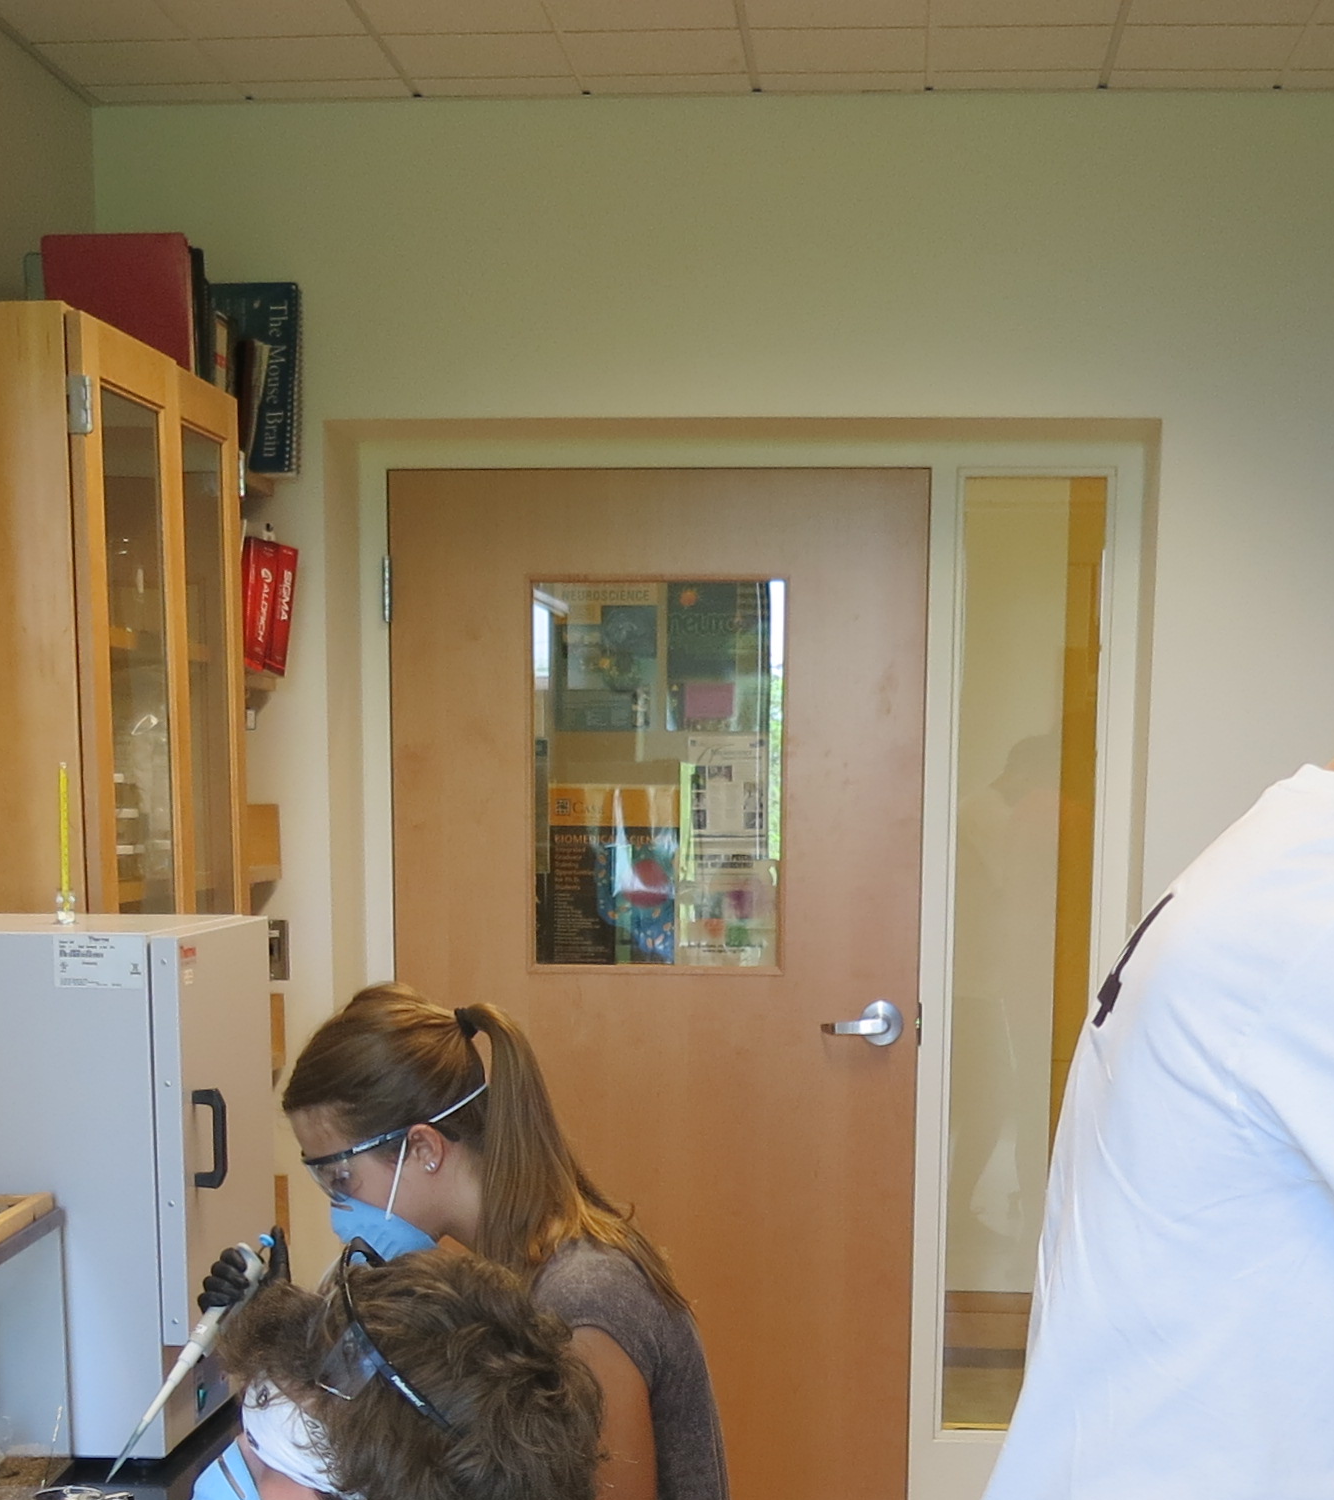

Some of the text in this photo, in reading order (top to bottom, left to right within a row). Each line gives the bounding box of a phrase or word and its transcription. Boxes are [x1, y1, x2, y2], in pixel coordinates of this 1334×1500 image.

[262, 299, 289, 458] The Mouse Brain
[257, 584, 271, 643] ALDRICH
[280, 570, 293, 621] SIGMA
[561, 589, 650, 602] NEUROSCIENCE
[554, 834, 616, 845] BIOMEDICA
